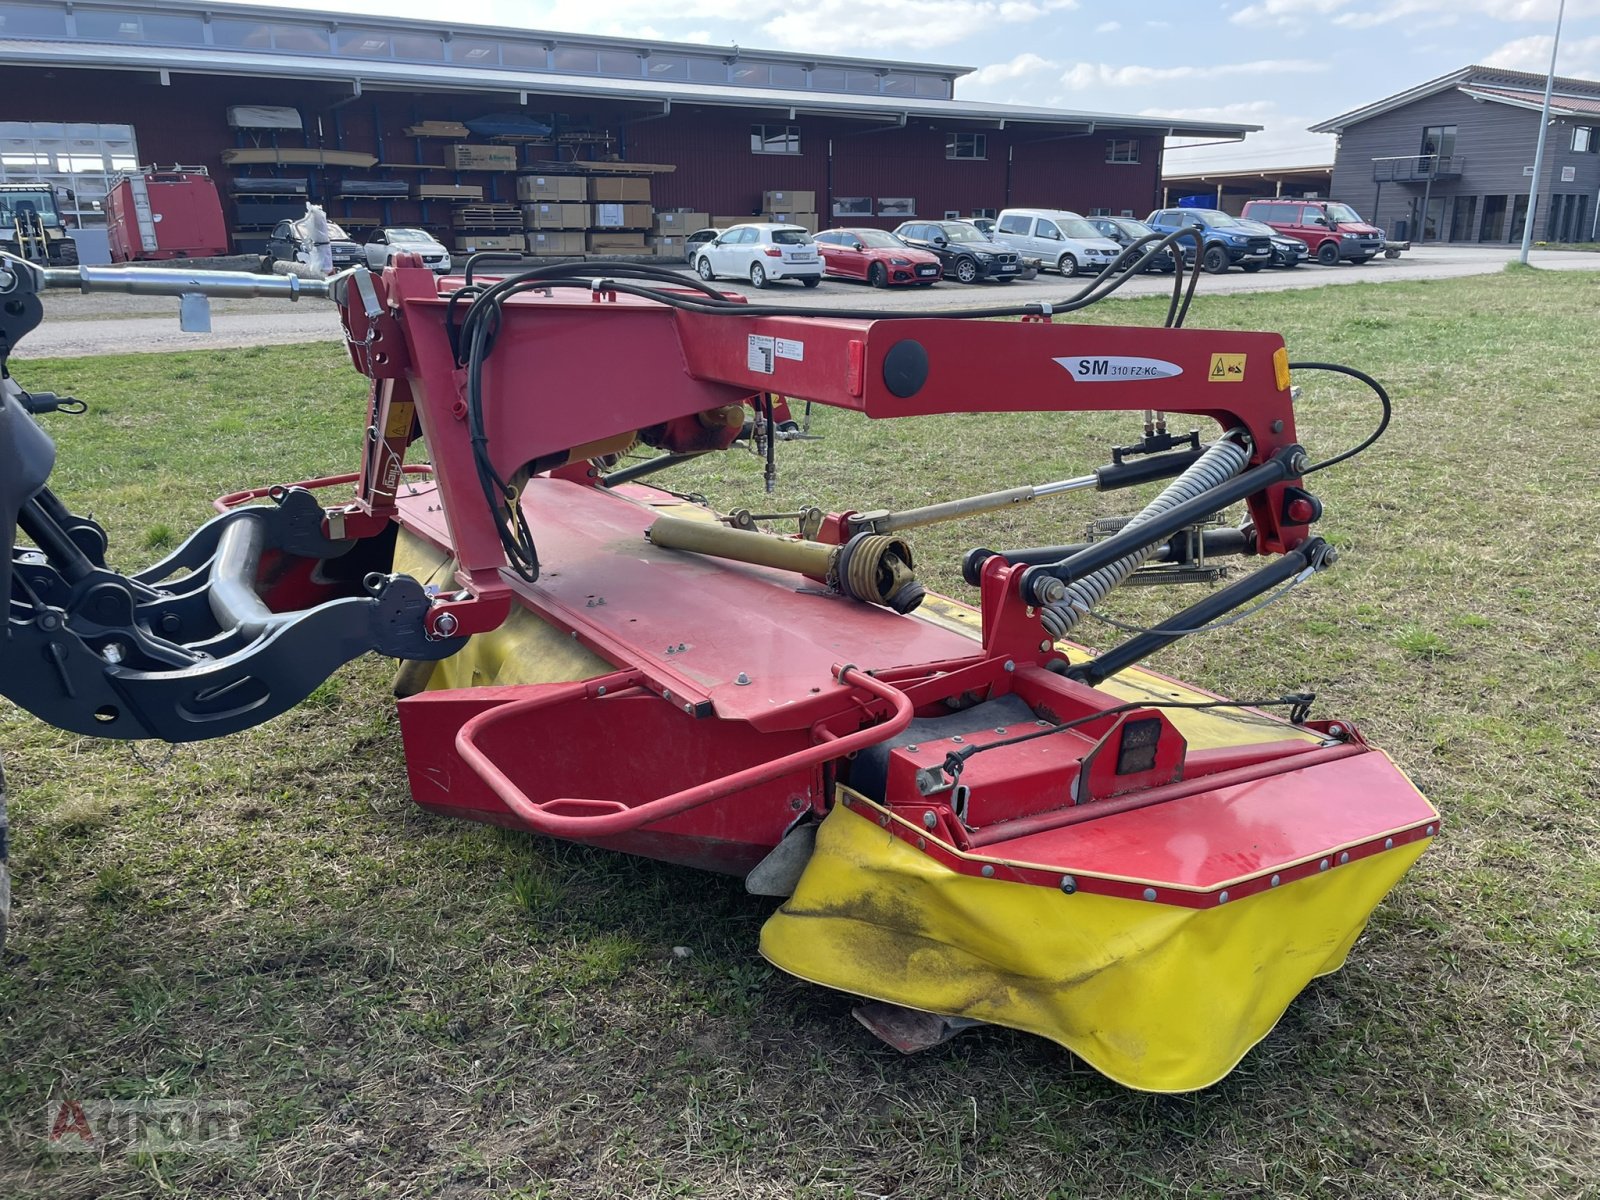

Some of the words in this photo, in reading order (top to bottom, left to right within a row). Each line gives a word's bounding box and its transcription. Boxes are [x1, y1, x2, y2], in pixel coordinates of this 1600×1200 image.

[1078, 359, 1109, 376] SM
[1111, 366, 1128, 376] 310
[385, 463, 400, 490] Fliegl
